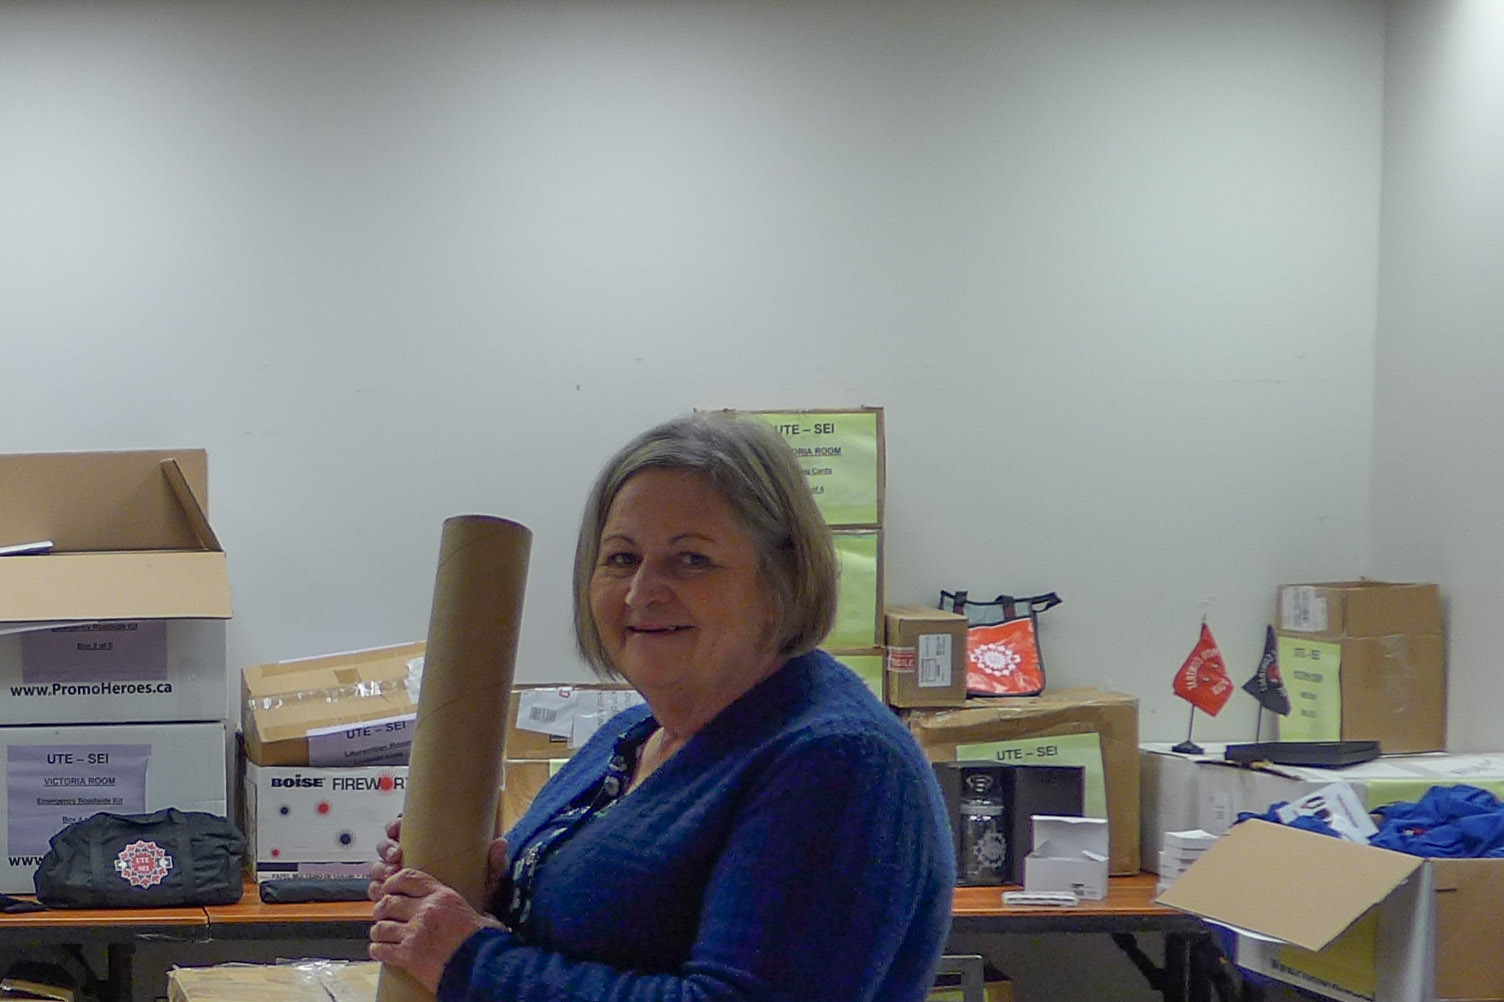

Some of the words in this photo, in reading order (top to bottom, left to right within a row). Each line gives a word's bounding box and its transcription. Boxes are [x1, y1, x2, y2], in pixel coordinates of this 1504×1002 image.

[814, 423, 834, 434] SEI
[814, 446, 842, 456] ROOM
[10, 682, 173, 697] www.PromoHeroes.ca
[347, 727, 372, 739] UTE
[386, 720, 406, 732] SEI
[47, 754, 73, 764] UTE
[87, 753, 109, 764] SEI
[997, 749, 1023, 761] UTE
[1036, 746, 1058, 757] SEI
[44, 777, 86, 787] VICTORIA
[88, 777, 115, 786] ROOM
